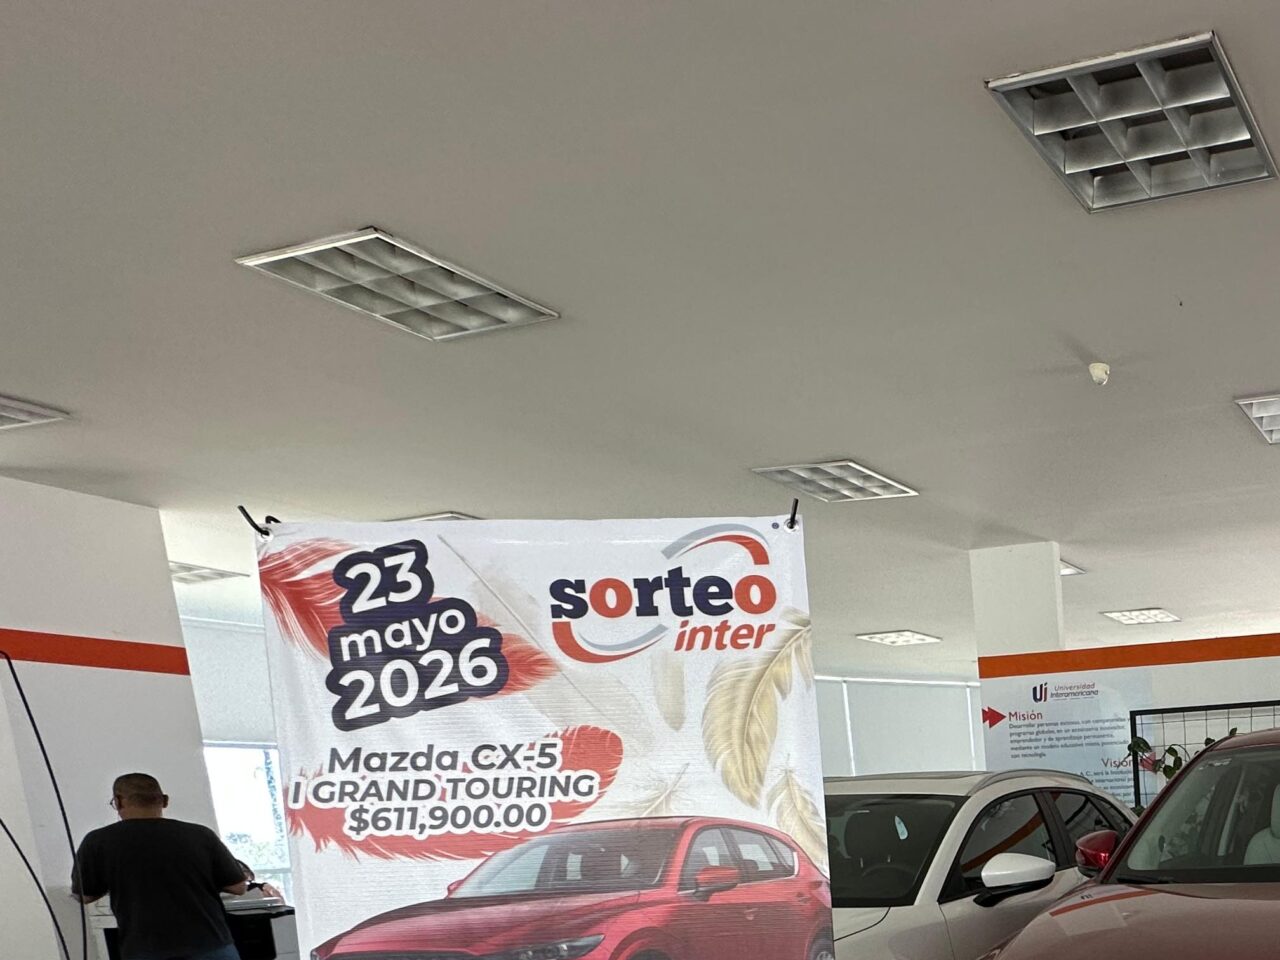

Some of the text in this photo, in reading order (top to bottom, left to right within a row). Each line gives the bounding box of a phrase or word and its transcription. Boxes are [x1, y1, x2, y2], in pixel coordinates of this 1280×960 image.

[345, 551, 423, 614] 23
[549, 565, 777, 619] sorteo
[340, 608, 466, 661] mayo
[674, 618, 776, 652] inter
[338, 638, 498, 720] 2026
[1008, 709, 1043, 722] Misión
[328, 741, 559, 774] Mazda CX-5
[312, 777, 437, 803] GRAND
[445, 774, 596, 802] TOURING
[349, 803, 548, 838] $611,900.00
